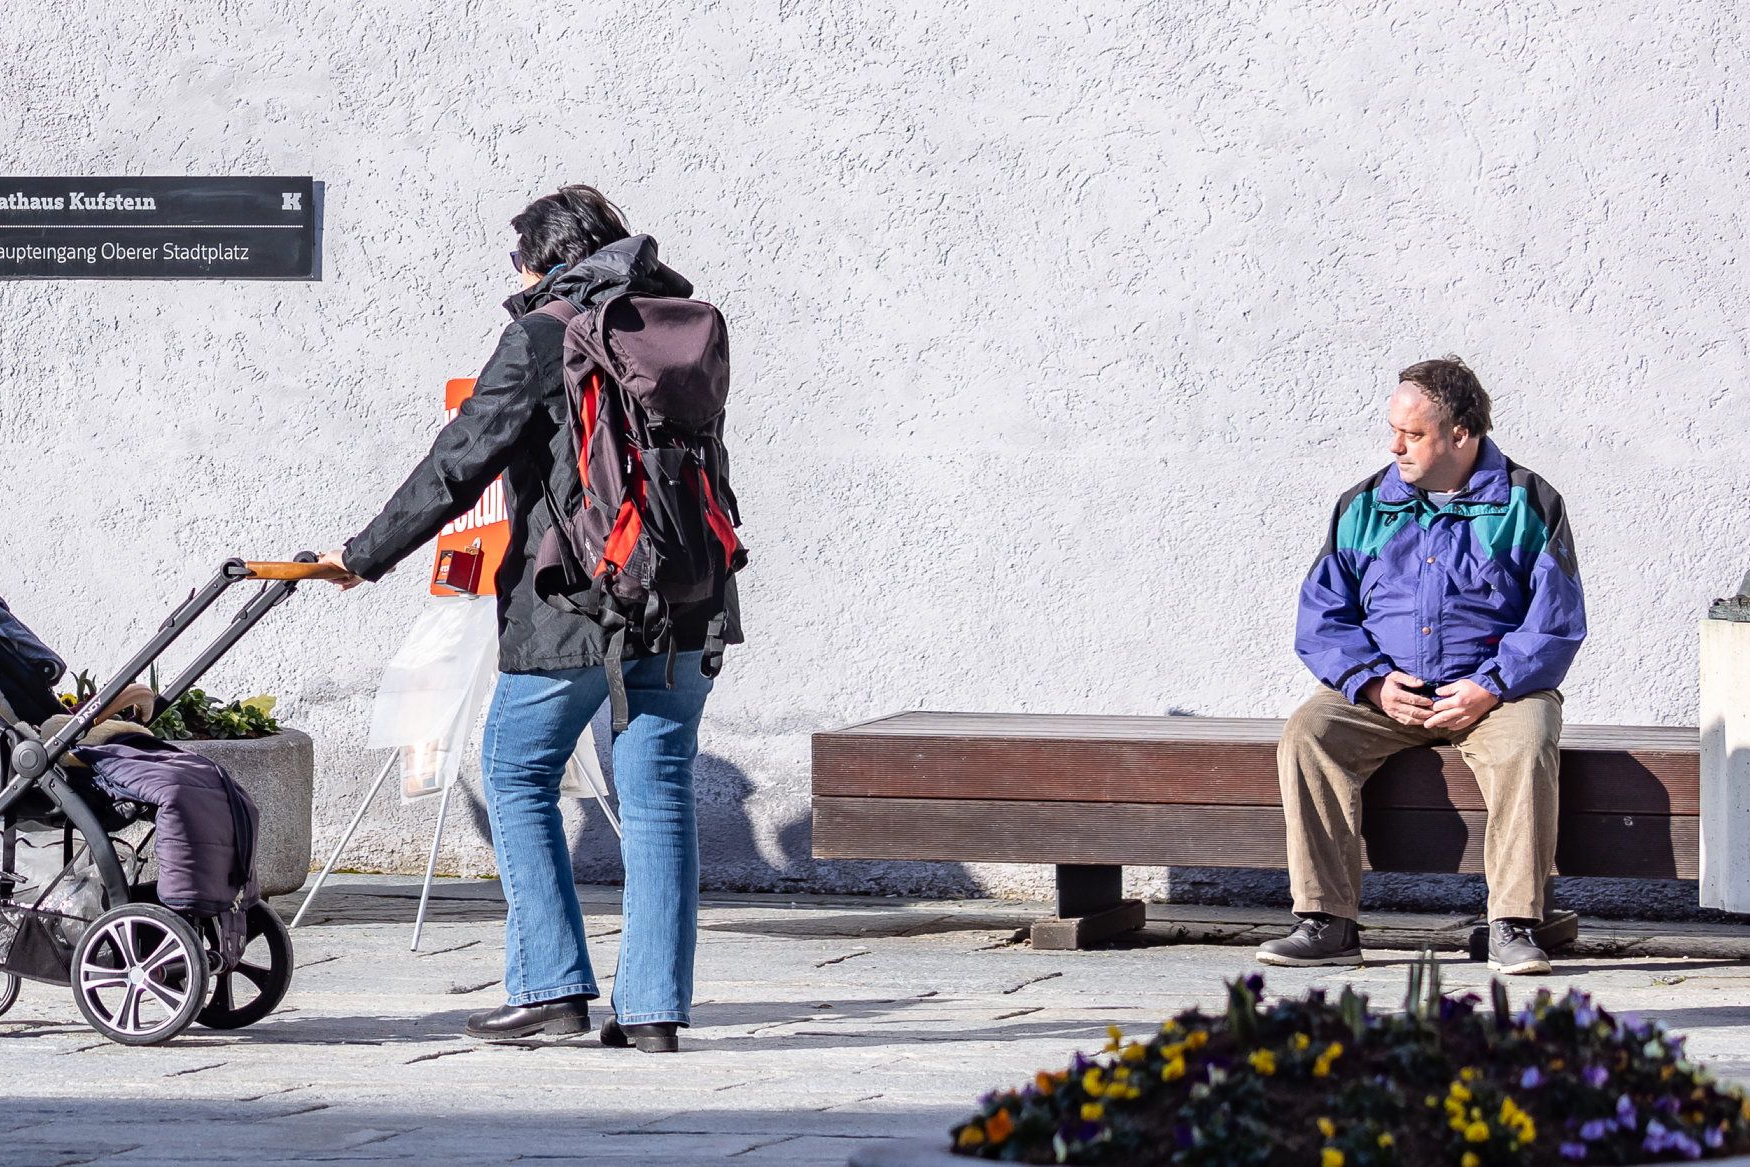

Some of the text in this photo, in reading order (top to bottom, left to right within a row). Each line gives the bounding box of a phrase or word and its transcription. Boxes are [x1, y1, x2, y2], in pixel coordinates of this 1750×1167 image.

[69, 192, 156, 211] Kufstein
[281, 192, 302, 211] K
[101, 242, 158, 260] Oberer
[163, 242, 250, 264] Stadtplatz
